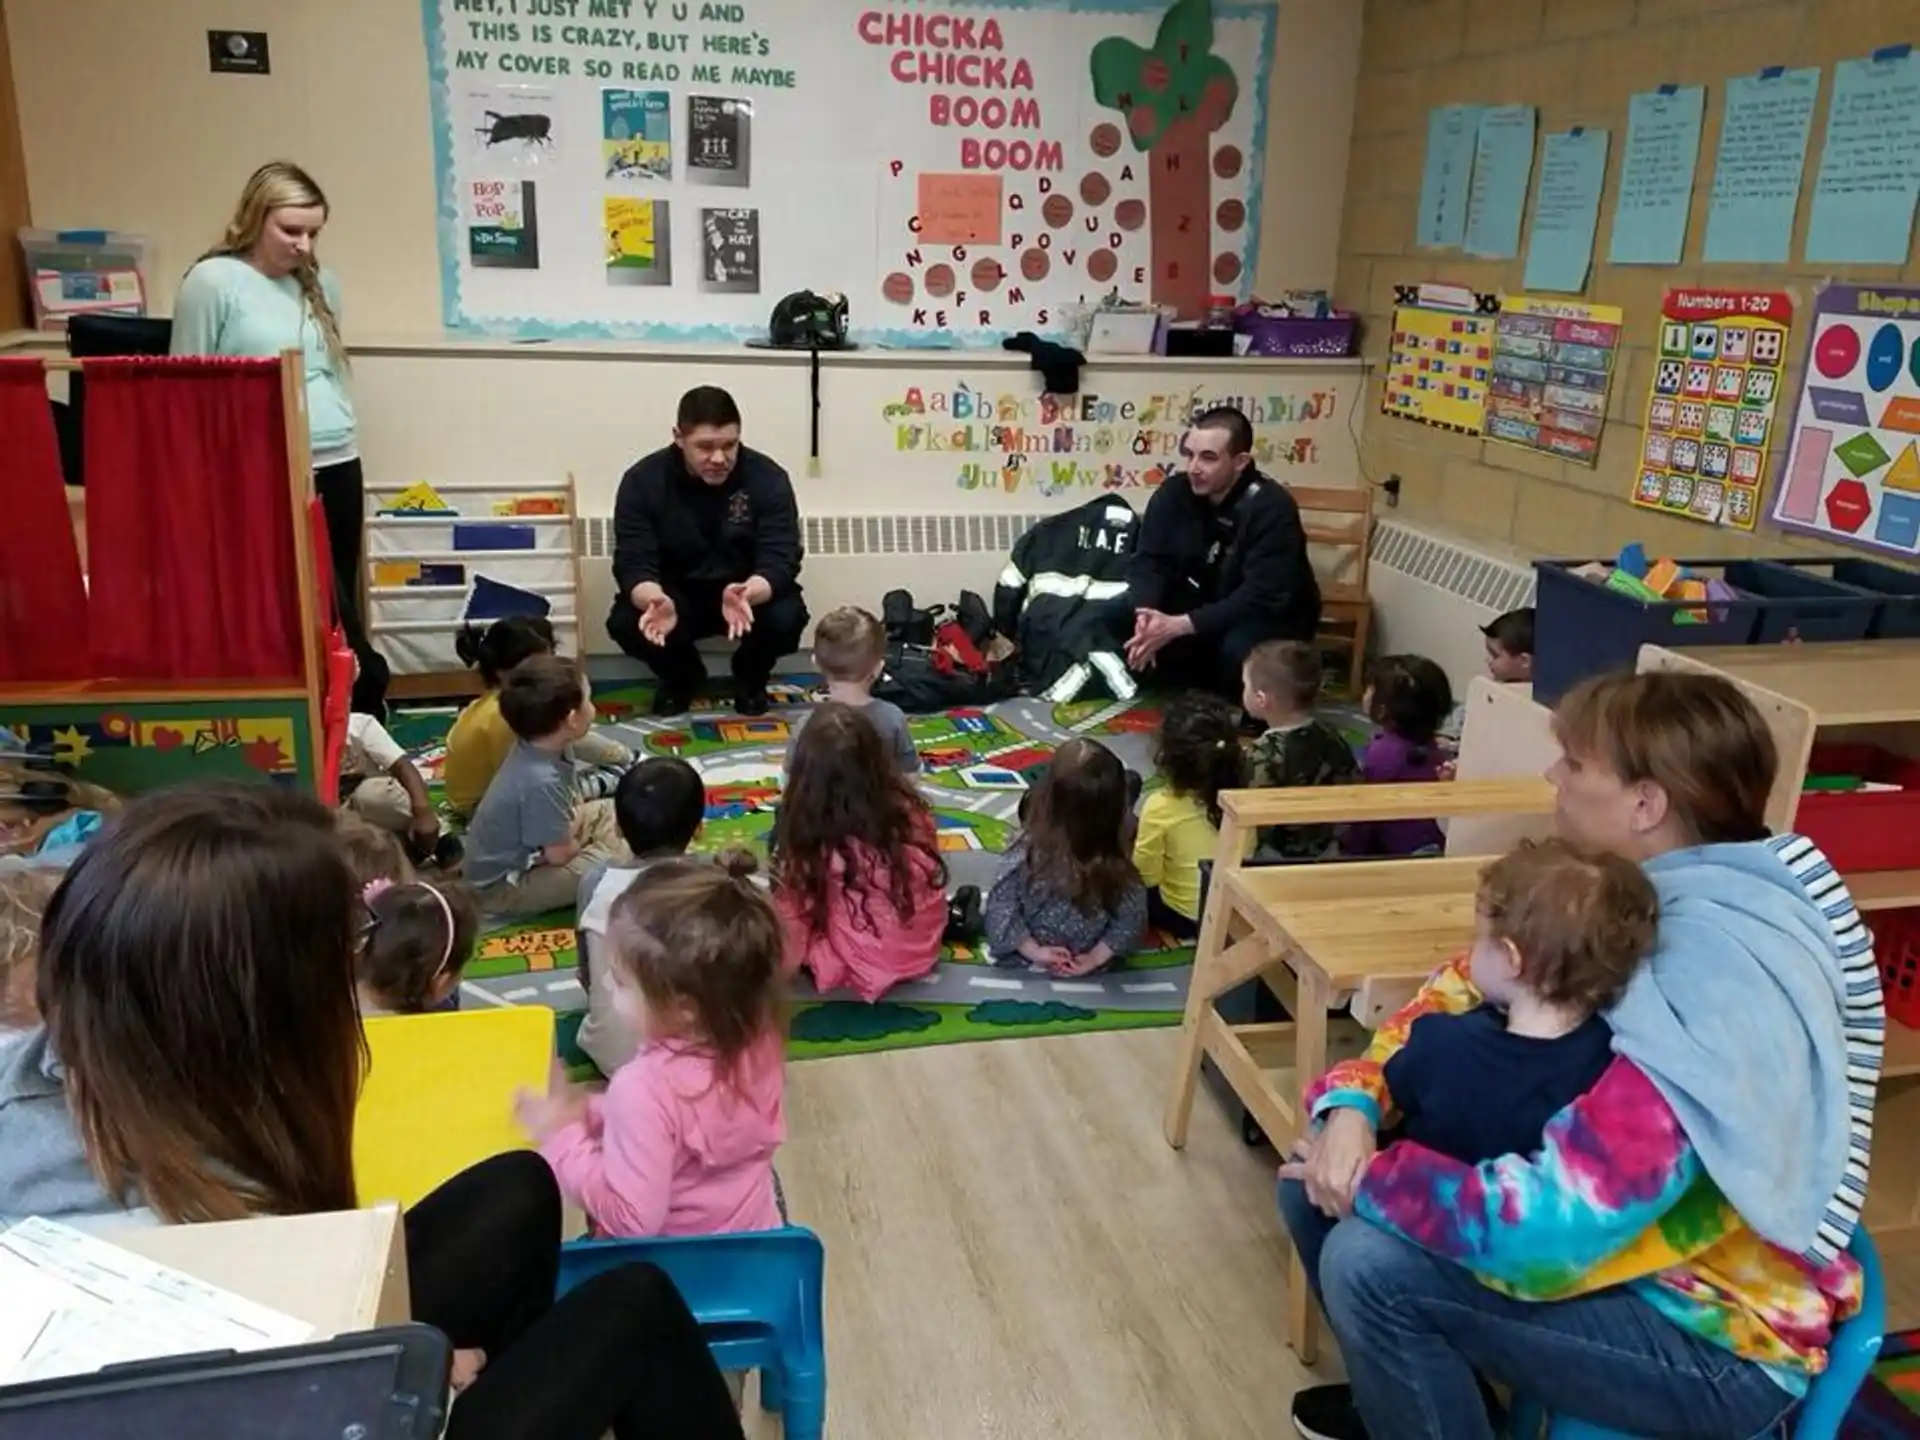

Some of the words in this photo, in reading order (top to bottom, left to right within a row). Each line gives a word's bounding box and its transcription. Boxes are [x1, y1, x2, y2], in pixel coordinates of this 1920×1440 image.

[454, 0, 503, 16] HEY,
[509, 0, 518, 14] I
[526, 0, 579, 17] JUST
[588, 0, 633, 18] MET
[700, 3, 745, 22] AND
[468, 21, 521, 42] THIS
[532, 24, 553, 44] IS
[561, 26, 641, 51] CRAZY,
[647, 32, 689, 53] BUT
[858, 11, 1004, 51] CHICKA
[456, 49, 489, 70] MY
[498, 53, 571, 75] COVER
[584, 59, 612, 78] SO
[623, 62, 681, 82] READ
[691, 64, 721, 83] ME
[731, 66, 796, 88] MAYBE
[890, 50, 1034, 91] CHICKA
[929, 94, 1041, 129] BOOM
[961, 138, 1064, 171] BOOM
[890, 160, 904, 177] P
[1120, 165, 1133, 181] A
[473, 182, 505, 197] HOP
[1039, 176, 1051, 193] D
[1009, 193, 1023, 210] Q
[475, 203, 506, 217] POP
[907, 216, 923, 232] C
[1085, 216, 1099, 232] U
[728, 234, 754, 246] HAT
[1012, 234, 1023, 249] P
[1038, 233, 1051, 249] O
[1110, 233, 1122, 248] D
[906, 249, 923, 267] N
[952, 245, 967, 261] G
[1062, 250, 1076, 265] V
[1134, 267, 1145, 283] E
[956, 291, 967, 307] F
[1008, 287, 1025, 305] M
[1677, 292, 1736, 310] Numbers
[1741, 296, 1772, 313] 1-20
[912, 308, 926, 325] K
[936, 311, 947, 327] E
[979, 310, 991, 326] R
[1037, 310, 1048, 324] S
